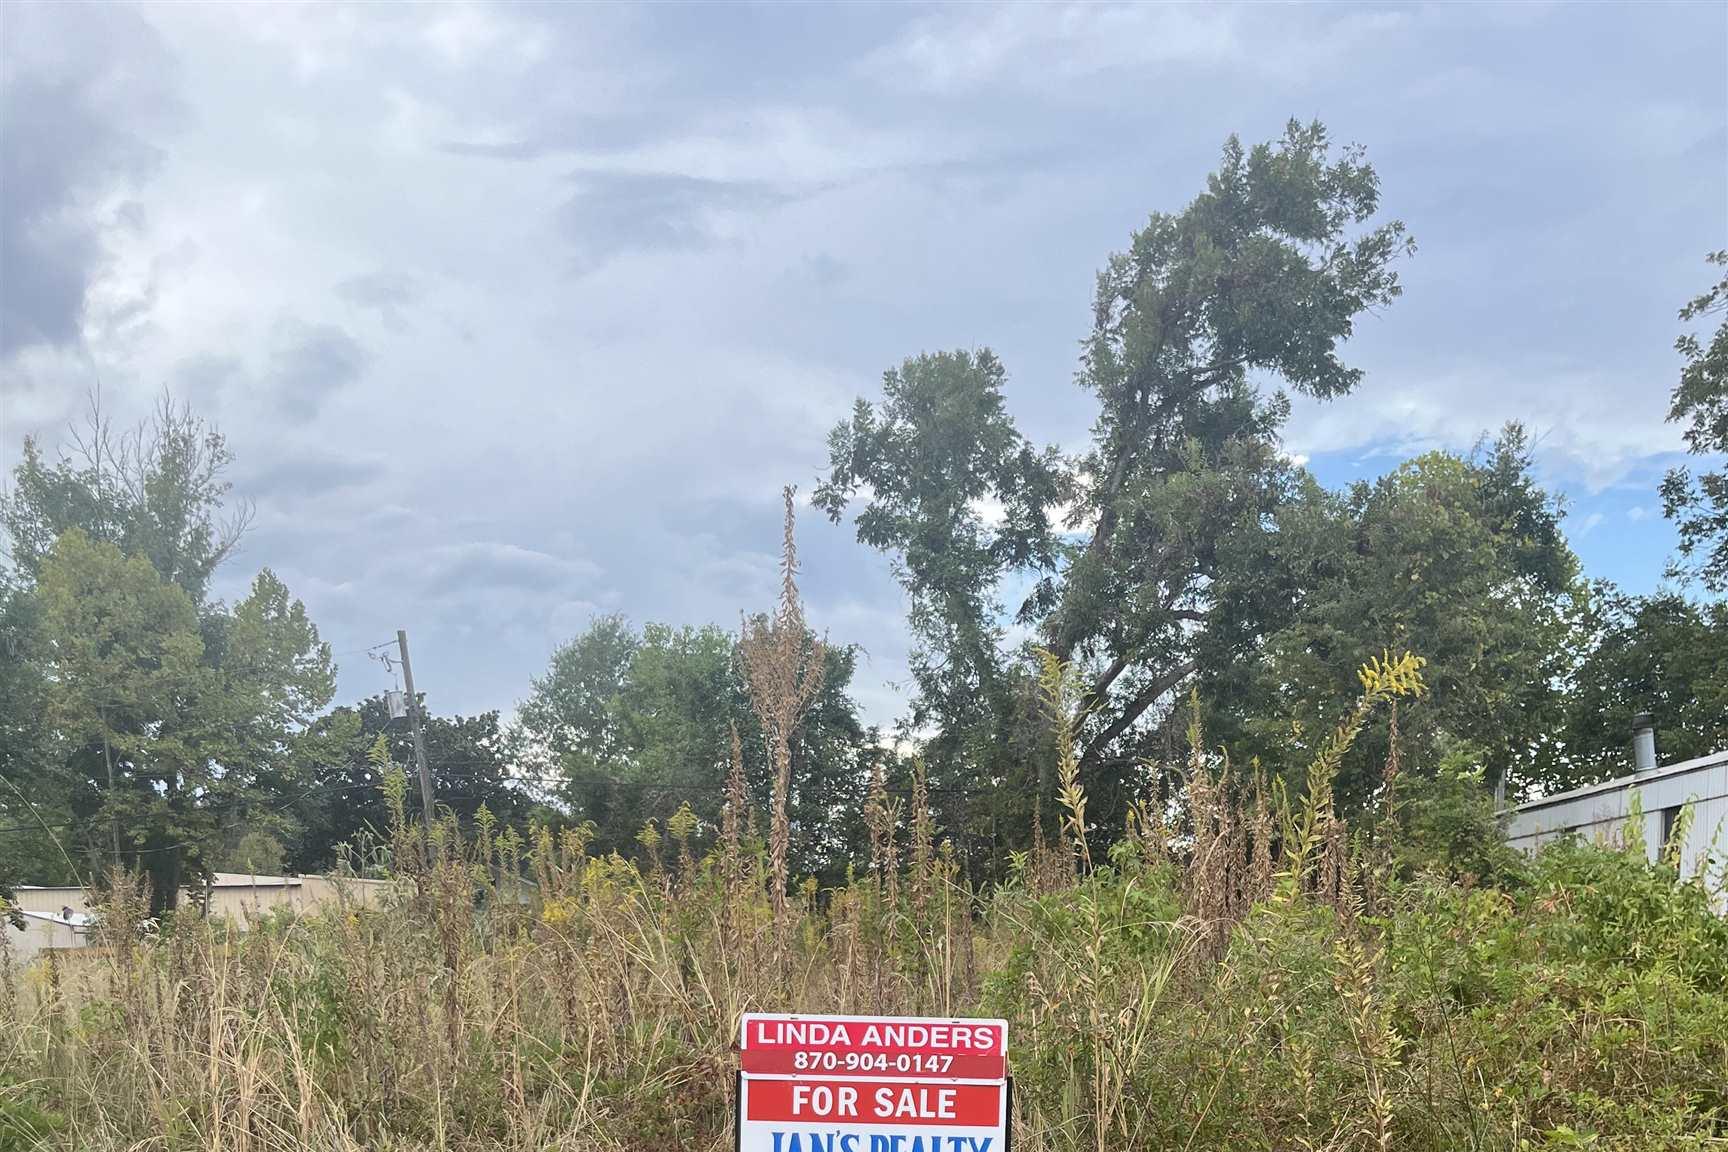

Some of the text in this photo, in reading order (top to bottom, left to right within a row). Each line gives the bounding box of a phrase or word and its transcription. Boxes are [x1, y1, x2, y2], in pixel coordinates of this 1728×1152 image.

[758, 1023, 994, 1049] LINDA ANDERS
[794, 1052, 953, 1072] 870-904-0147
[792, 1086, 957, 1118] FOR SALE
